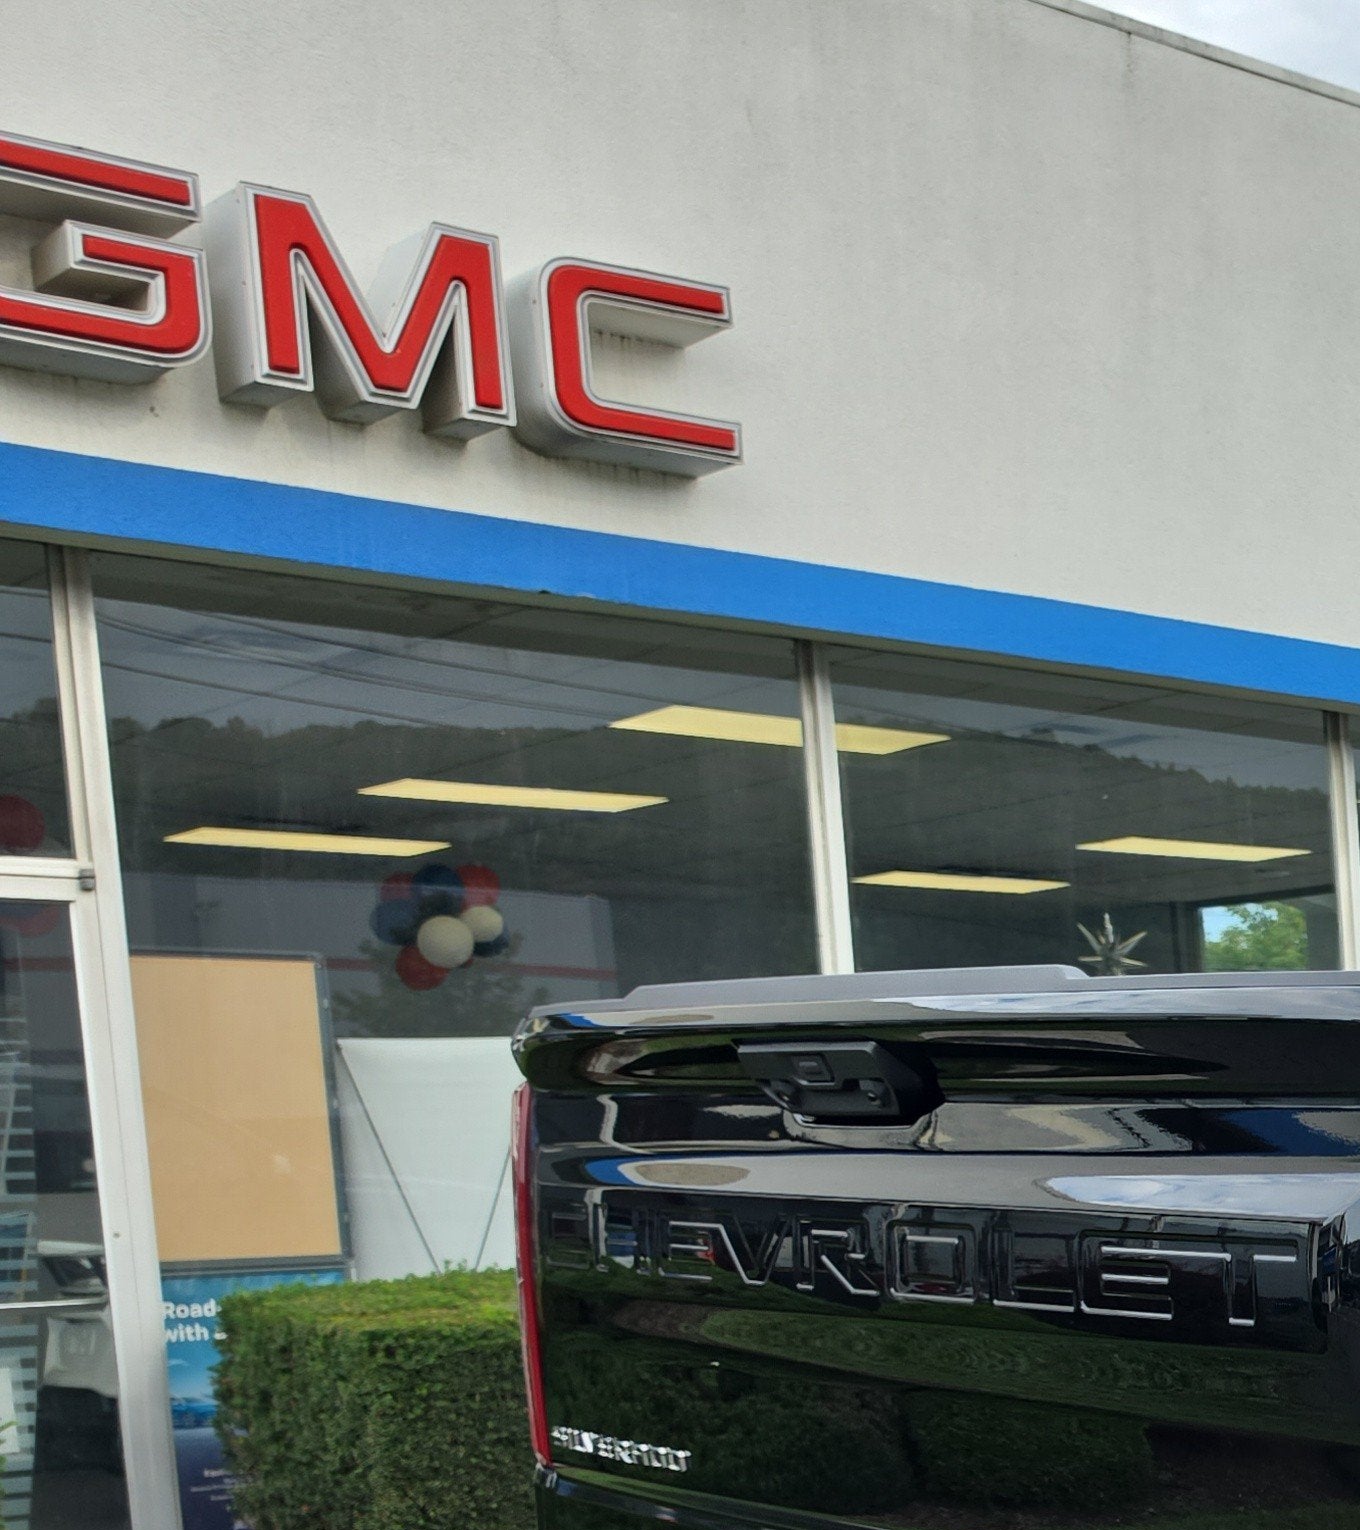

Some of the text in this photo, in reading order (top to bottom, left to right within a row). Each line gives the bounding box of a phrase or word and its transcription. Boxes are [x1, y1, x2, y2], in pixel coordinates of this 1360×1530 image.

[0, 131, 743, 466] GMC
[543, 1200, 1298, 1328] CHEVROLET
[551, 1425, 692, 1472] SILVERADO
